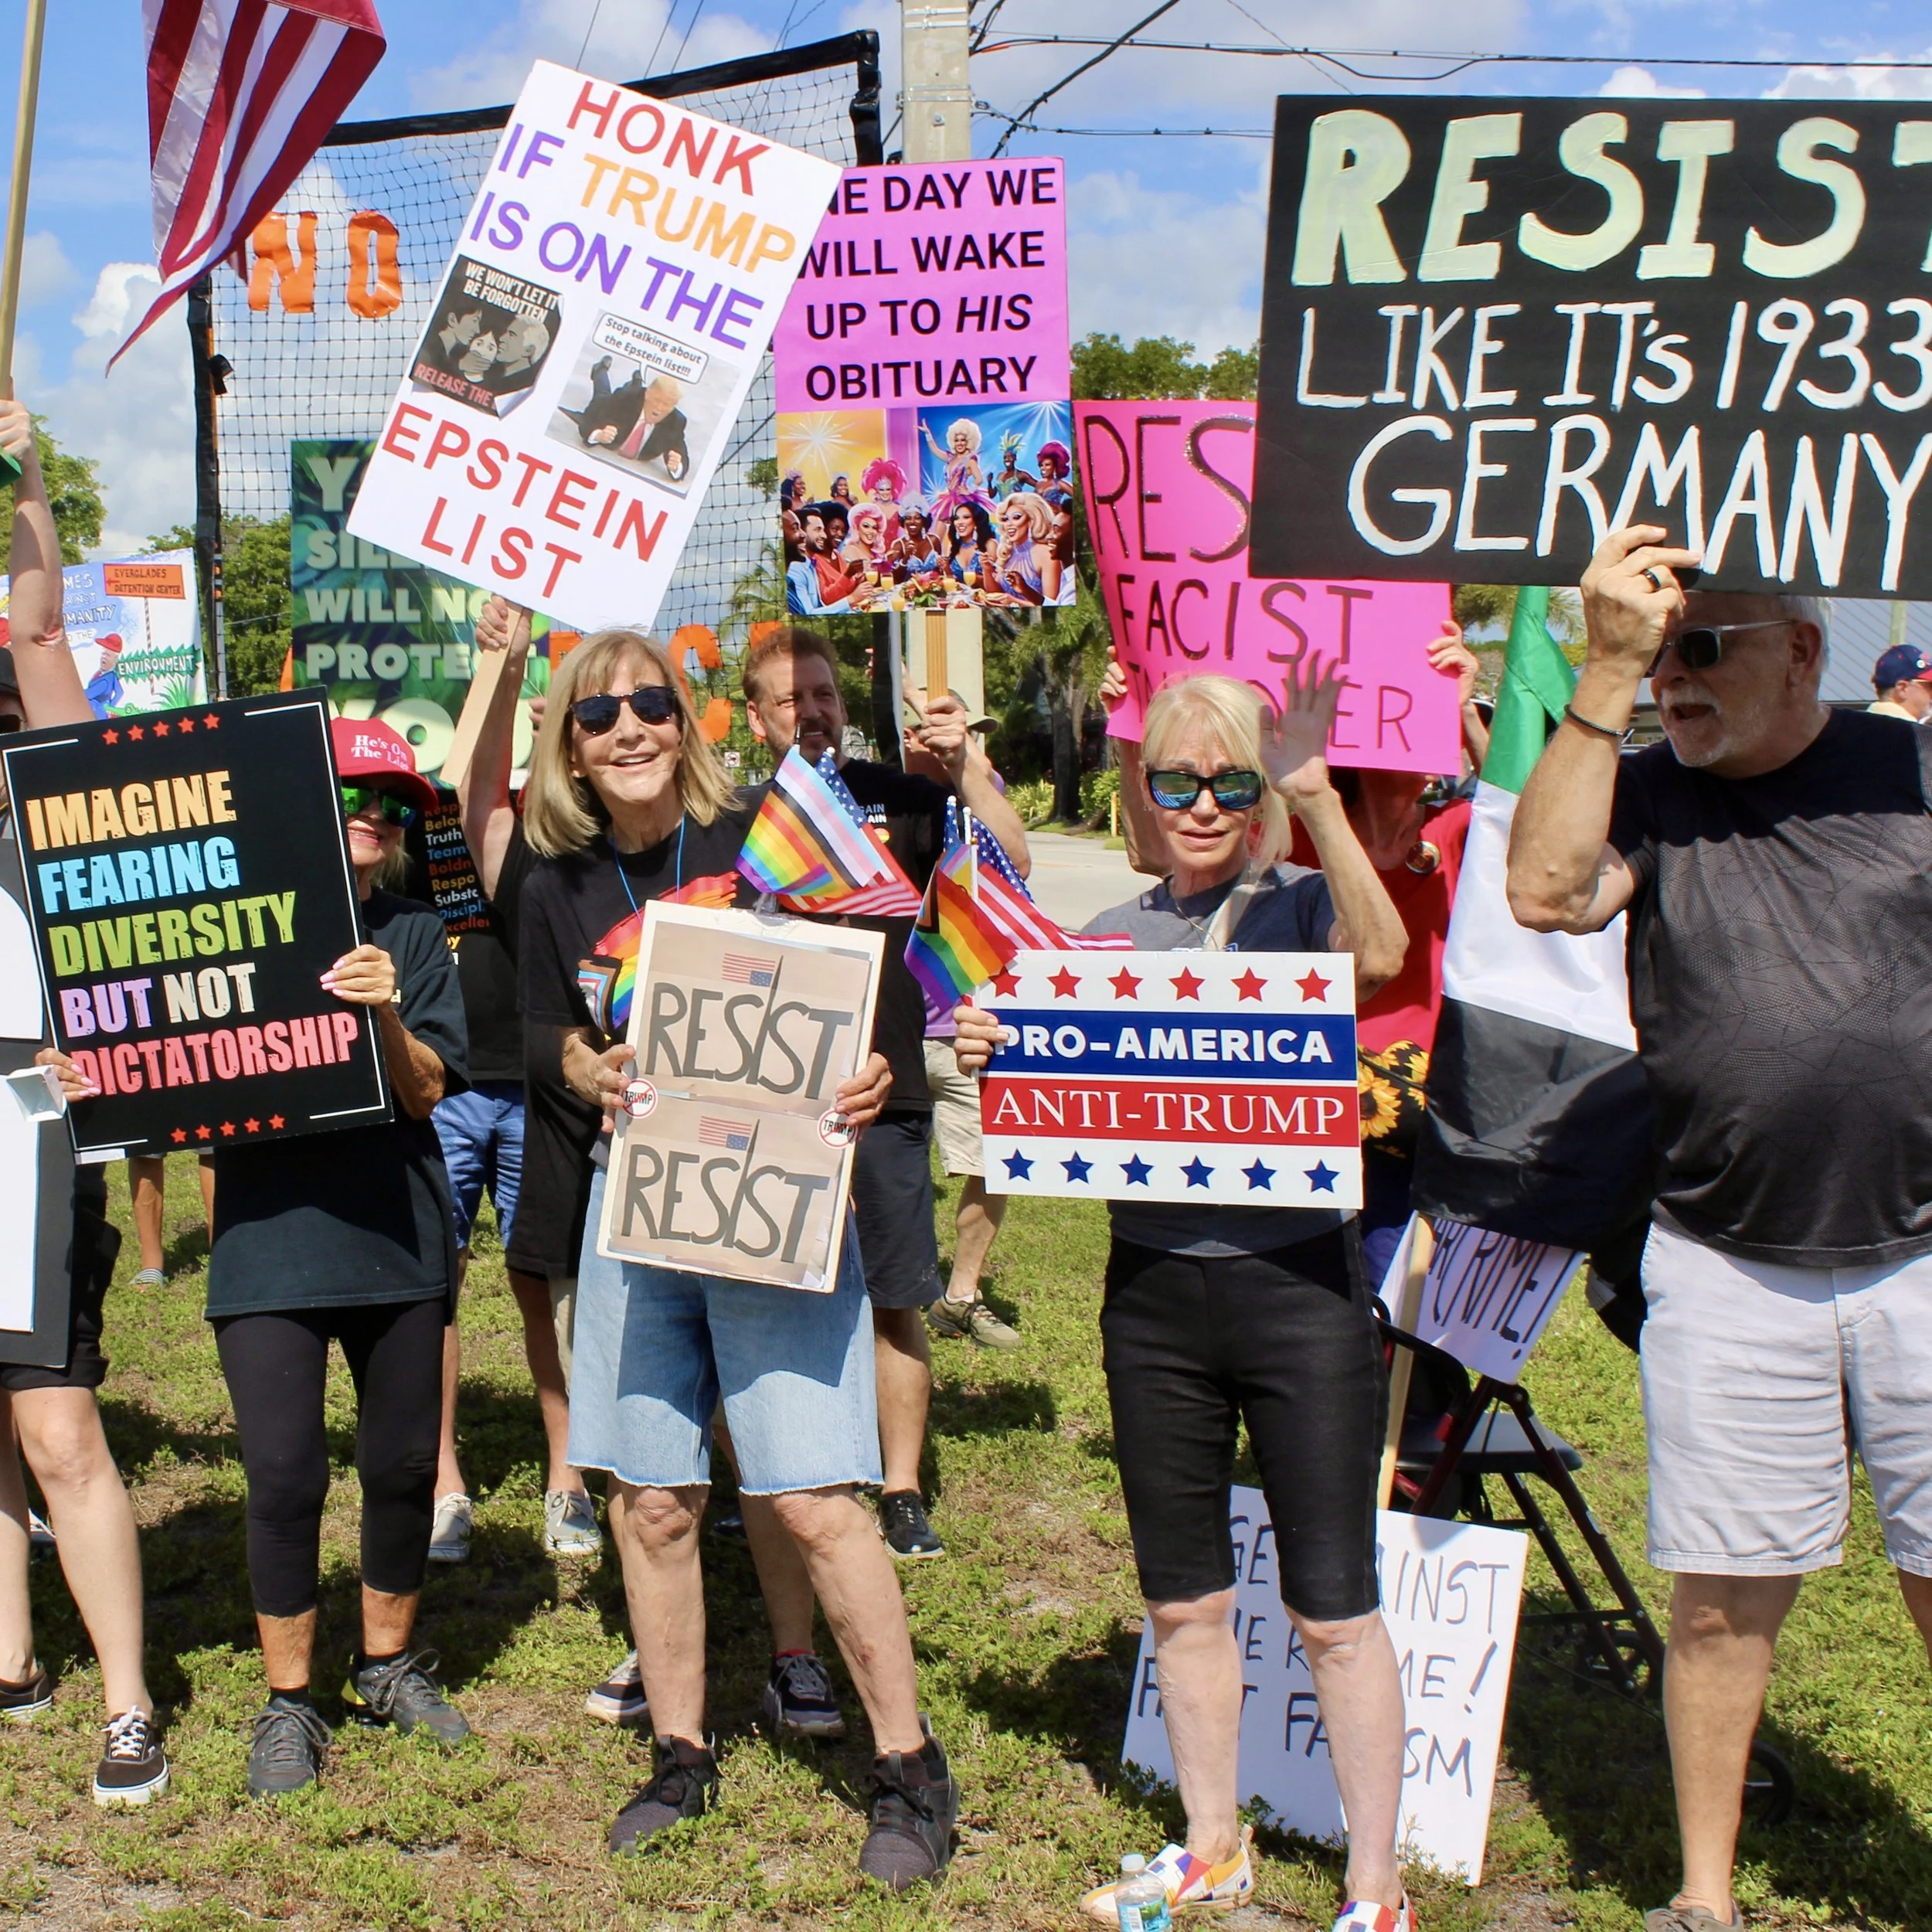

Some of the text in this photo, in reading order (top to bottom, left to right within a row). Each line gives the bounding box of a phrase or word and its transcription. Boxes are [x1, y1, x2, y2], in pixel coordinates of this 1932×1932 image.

[566, 81, 771, 196] HONK
[498, 124, 796, 274] IF TRUMP
[883, 172, 971, 213] DAY
[986, 167, 1056, 206] WE
[247, 210, 402, 318] NO
[470, 192, 765, 350] IS ON THE
[798, 230, 1046, 279] WILL WAKE
[463, 280, 548, 322] BE FORGOTTEN
[464, 262, 559, 311] WE WON'T LET IT
[806, 294, 1032, 340] UP TO HIS
[604, 335, 622, 349] the
[624, 342, 662, 366] Epstein
[605, 318, 702, 364] Stop talking about
[1297, 297, 1932, 412] LIKE IT's 1933
[413, 364, 493, 406] RELEASE THE
[805, 355, 1037, 401] OBITUARY
[382, 402, 669, 563] EPSTEIN
[1083, 413, 1256, 563] RES
[1346, 413, 1932, 591] GERMANY
[420, 496, 583, 599] LIST
[63, 573, 94, 590] MES
[114, 569, 167, 579] EVERGLADES
[114, 583, 181, 595] DETENTION CENTER
[63, 604, 117, 626] MANITY
[304, 587, 494, 624] WILL NO
[1117, 573, 1373, 665] FACIST
[117, 655, 194, 676] ENVIRONMENT
[306, 643, 537, 681] PROTE
[351, 746, 383, 759] The
[355, 734, 408, 761] He's On
[26, 770, 236, 851] IMAGINE
[867, 814, 887, 824] AIN
[425, 828, 463, 845] Truth
[37, 835, 240, 914] FEARING
[428, 858, 472, 876] Boldn
[431, 874, 475, 893] Respo
[439, 900, 485, 920] Discipl
[48, 890, 297, 977] DIVERSITY
[59, 962, 257, 1039] BUT NOT
[645, 955, 853, 1100] RESIST
[996, 1024, 1332, 1063] PRO-AMERICA
[70, 1011, 359, 1096] DICTATORSHIP
[624, 1091, 653, 1104] TRUMP
[992, 1087, 1345, 1136] ANTI-TRUMP
[824, 1120, 852, 1136] TRUMP
[621, 1119, 830, 1263] RESIST
[1376, 1542, 1509, 1634] INST
[1285, 1692, 1472, 1798] FASM
